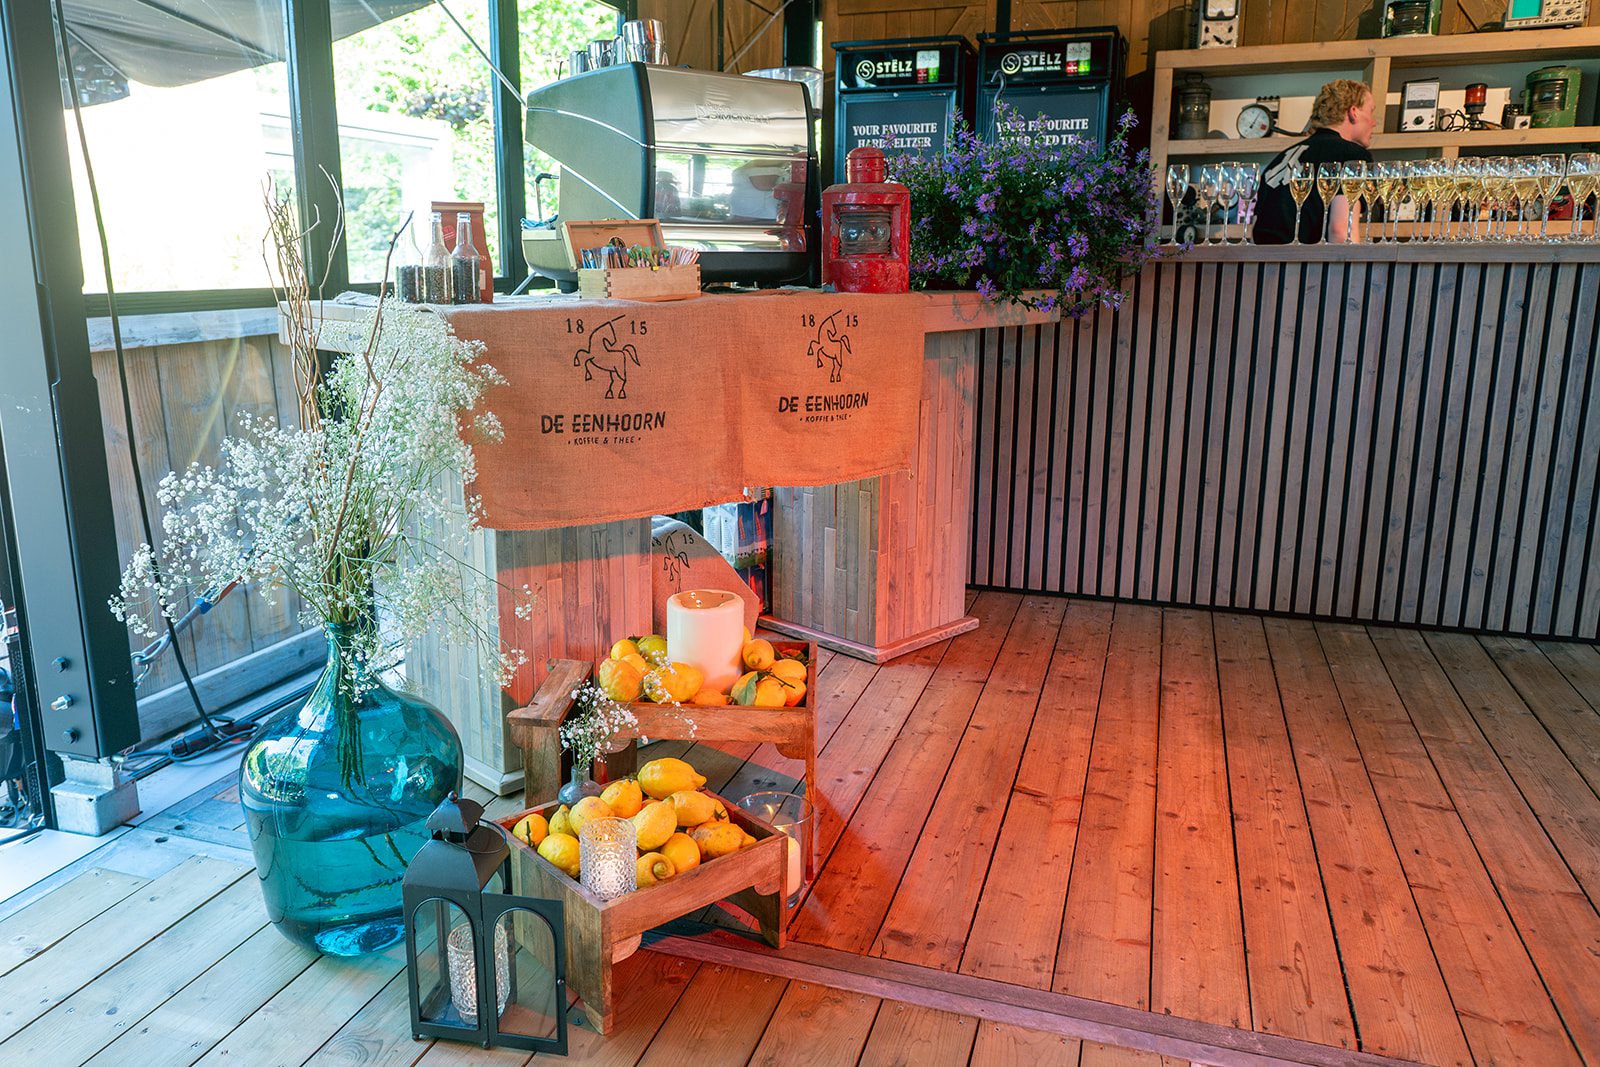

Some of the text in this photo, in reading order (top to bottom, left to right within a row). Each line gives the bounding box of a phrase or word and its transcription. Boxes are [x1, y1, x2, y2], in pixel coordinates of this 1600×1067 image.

[1022, 51, 1061, 66] STËLZ
[876, 59, 912, 73] STËLZ
[852, 122, 938, 136] YOUR FAVOURITE
[1028, 119, 1089, 131] FOURITE
[889, 136, 932, 149] ELTZER
[566, 318, 648, 335] 18 15
[801, 314, 859, 328] 18 15
[778, 392, 869, 413] DE EENHOORN
[541, 411, 666, 434] DE EENHOORN
[805, 415, 829, 423] KOFFIE
[574, 437, 599, 446] KOFFIE
[613, 436, 636, 444] THEE
[682, 533, 695, 545] 15
